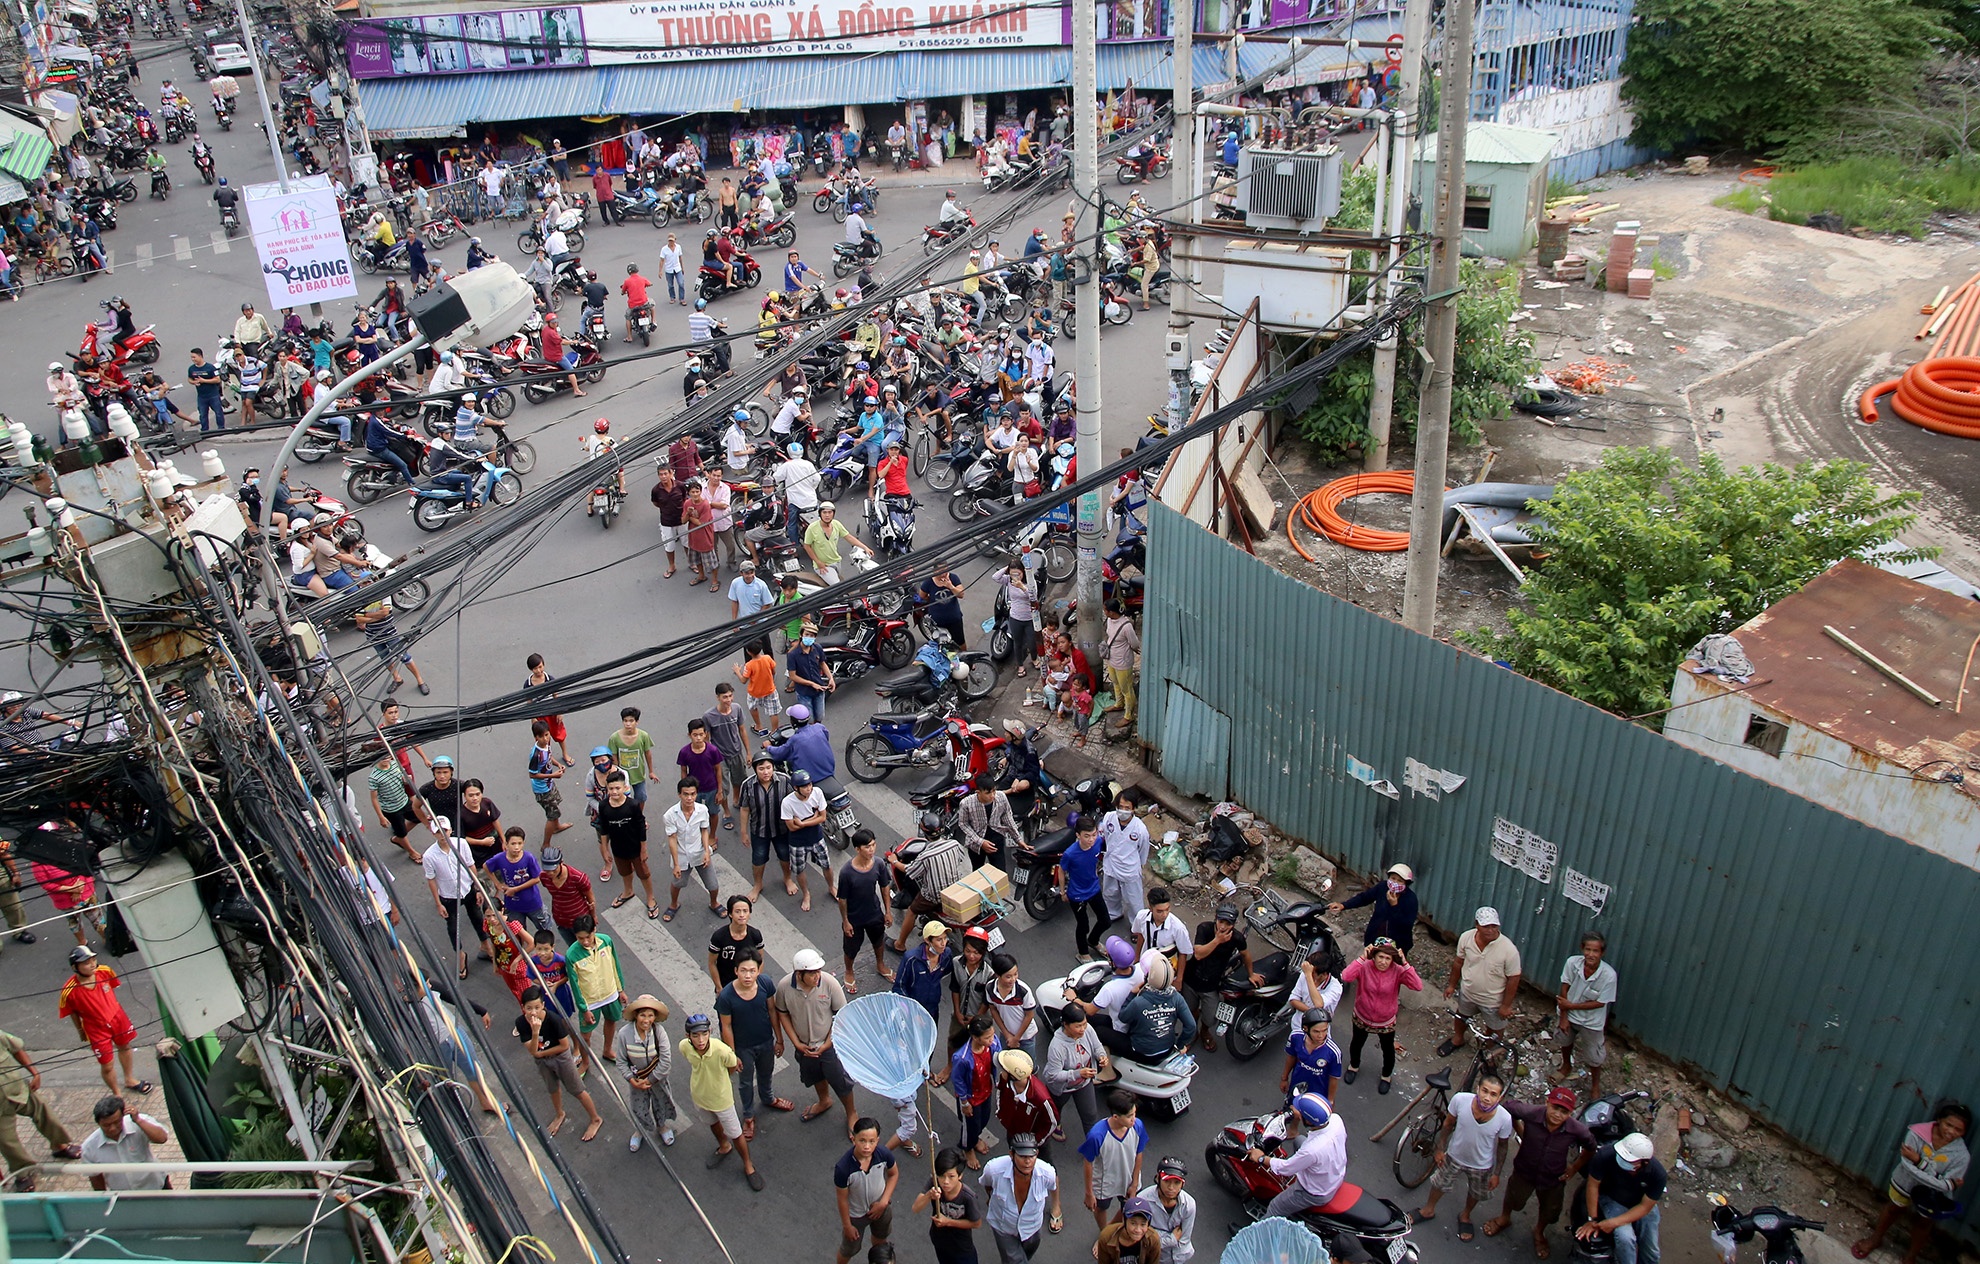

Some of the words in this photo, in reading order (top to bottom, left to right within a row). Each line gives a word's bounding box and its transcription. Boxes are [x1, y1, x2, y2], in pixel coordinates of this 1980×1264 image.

[651, 5, 676, 14] BAN
[680, 2, 715, 12] NHÂN
[720, 0, 745, 9] DÂN
[657, 11, 773, 47] THƯƠNG
[787, 5, 825, 41] XÁ
[837, 0, 915, 39] ĐỒNG
[929, 0, 1028, 35] KHÁNH
[797, 44, 806, 52] B
[722, 950, 736, 960] 07
